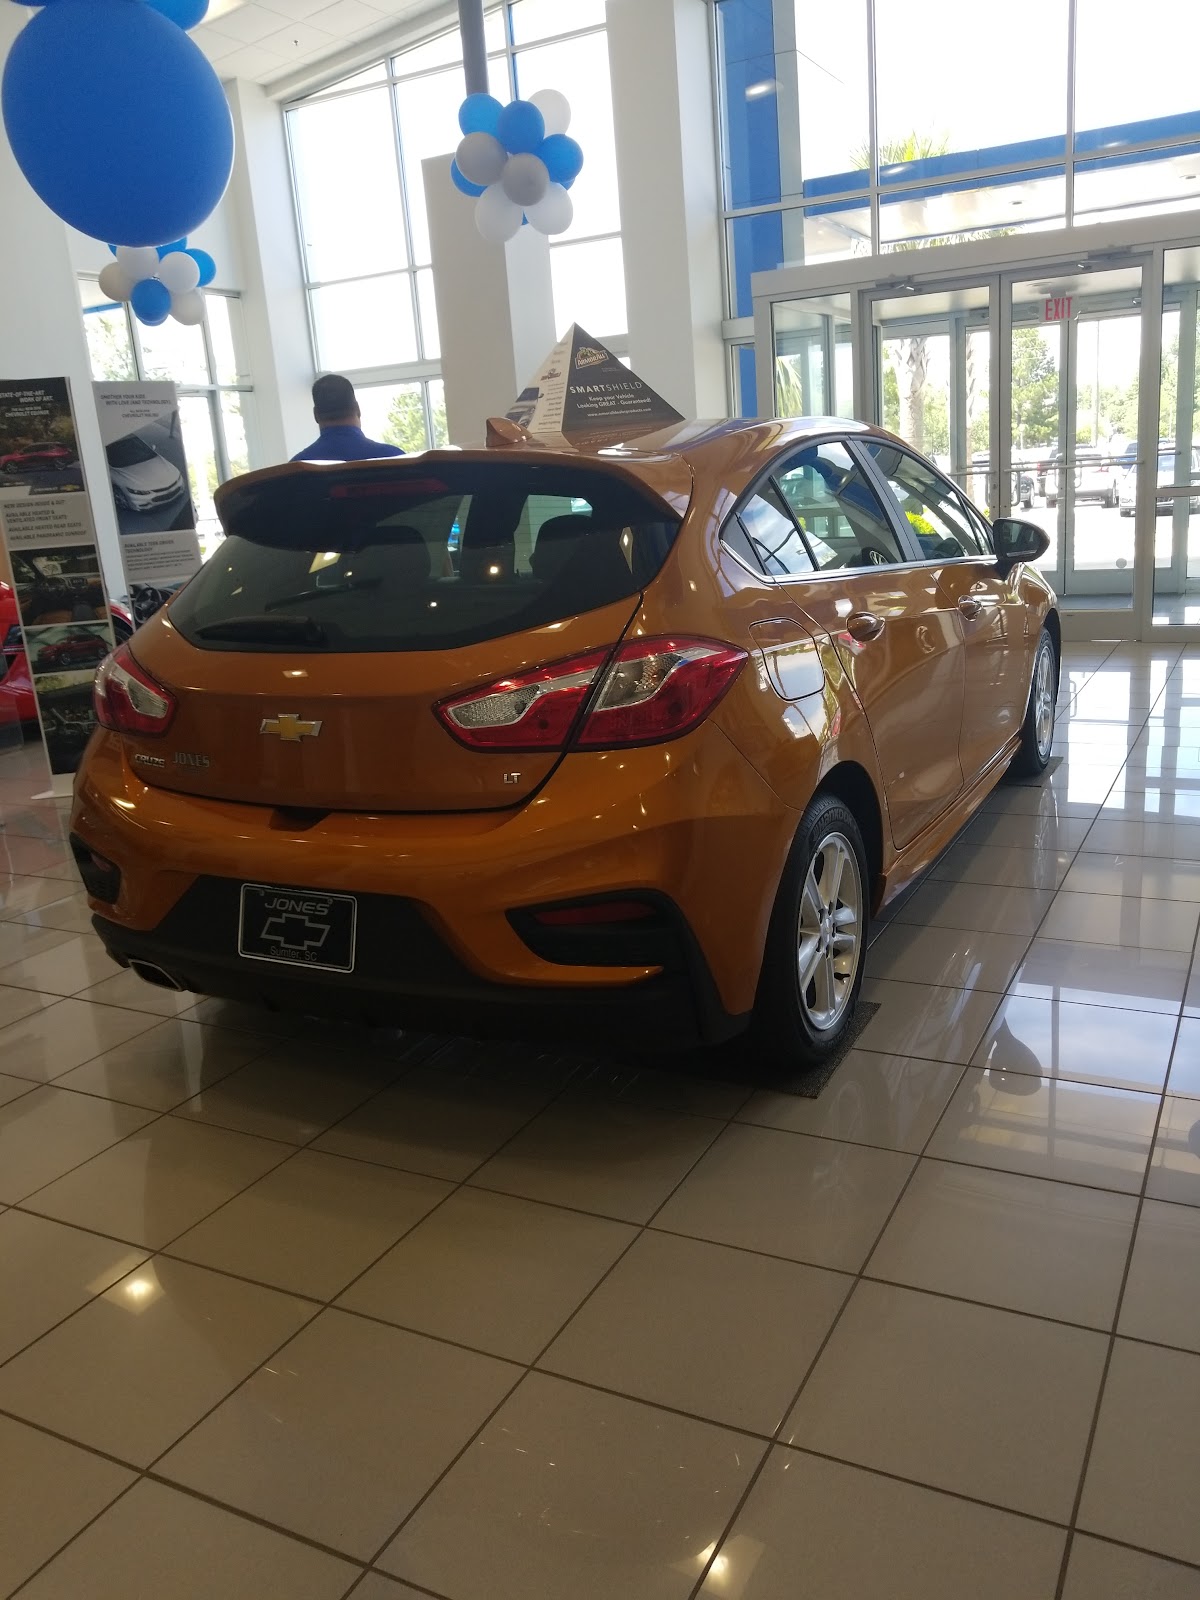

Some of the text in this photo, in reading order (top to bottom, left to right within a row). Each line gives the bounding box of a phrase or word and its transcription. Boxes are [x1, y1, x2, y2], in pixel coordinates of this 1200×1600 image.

[1045, 296, 1073, 320] EXIT
[569, 381, 642, 394] SMARTSHIELD
[620, 397, 652, 405] Guaranteed!
[134, 753, 165, 768] CRUZE
[172, 751, 209, 768] JONES
[503, 772, 521, 784] LT
[264, 897, 330, 915] JONES
[304, 950, 318, 962] SC
